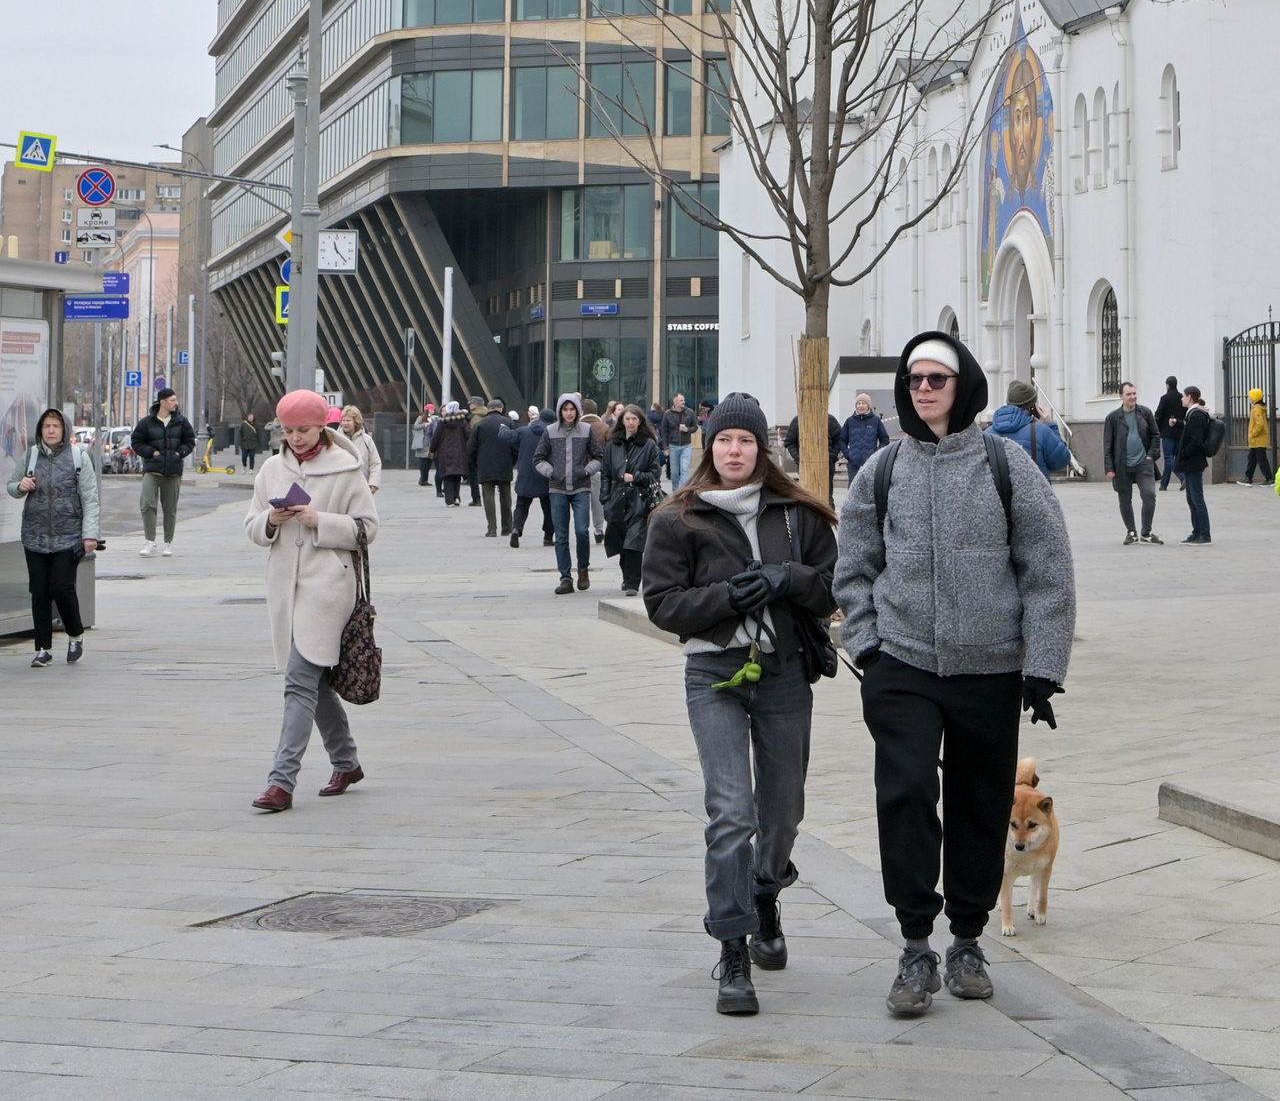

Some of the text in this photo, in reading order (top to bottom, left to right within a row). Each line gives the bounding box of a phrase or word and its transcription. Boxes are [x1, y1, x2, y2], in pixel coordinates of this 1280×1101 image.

[83, 220, 109, 228] кроме
[667, 323, 719, 331] STARS COFFE
